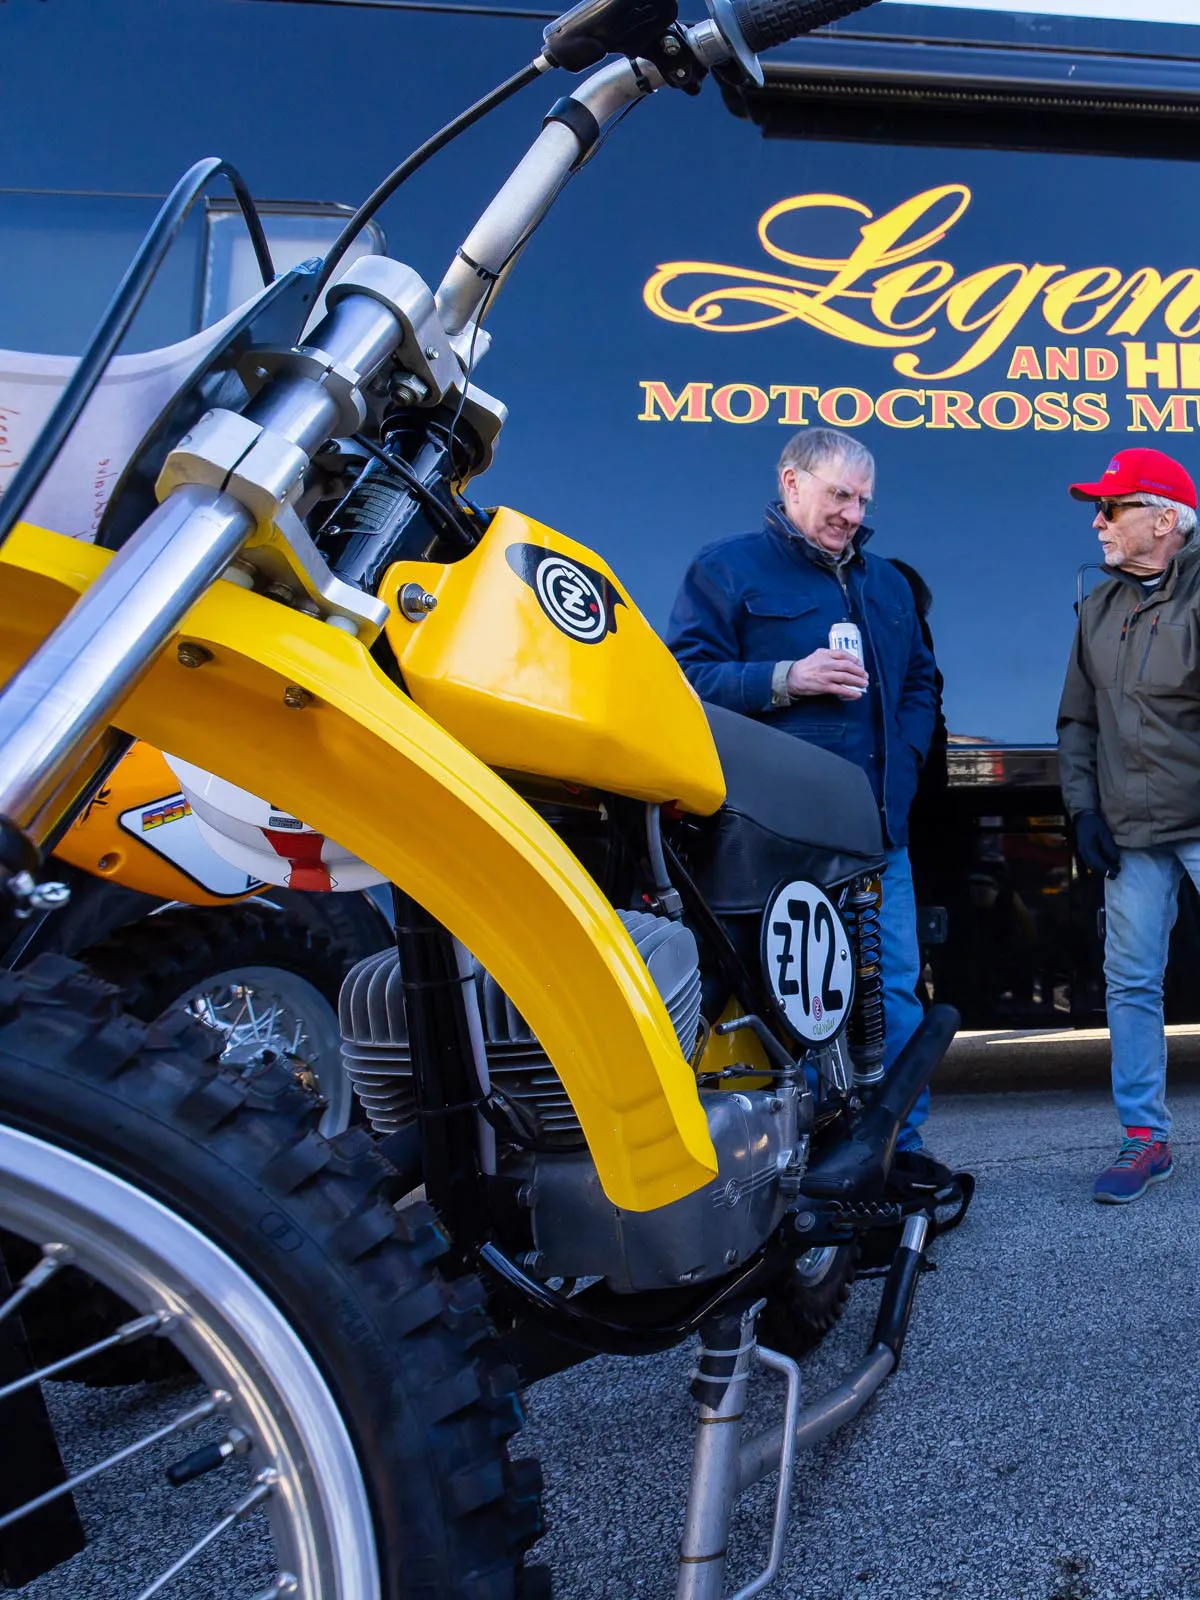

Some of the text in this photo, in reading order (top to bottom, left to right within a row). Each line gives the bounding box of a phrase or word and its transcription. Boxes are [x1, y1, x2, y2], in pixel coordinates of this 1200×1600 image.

[1007, 346, 1119, 380] AND
[638, 381, 1110, 431] MOTOCROSS
[141, 799, 193, 831] 55
